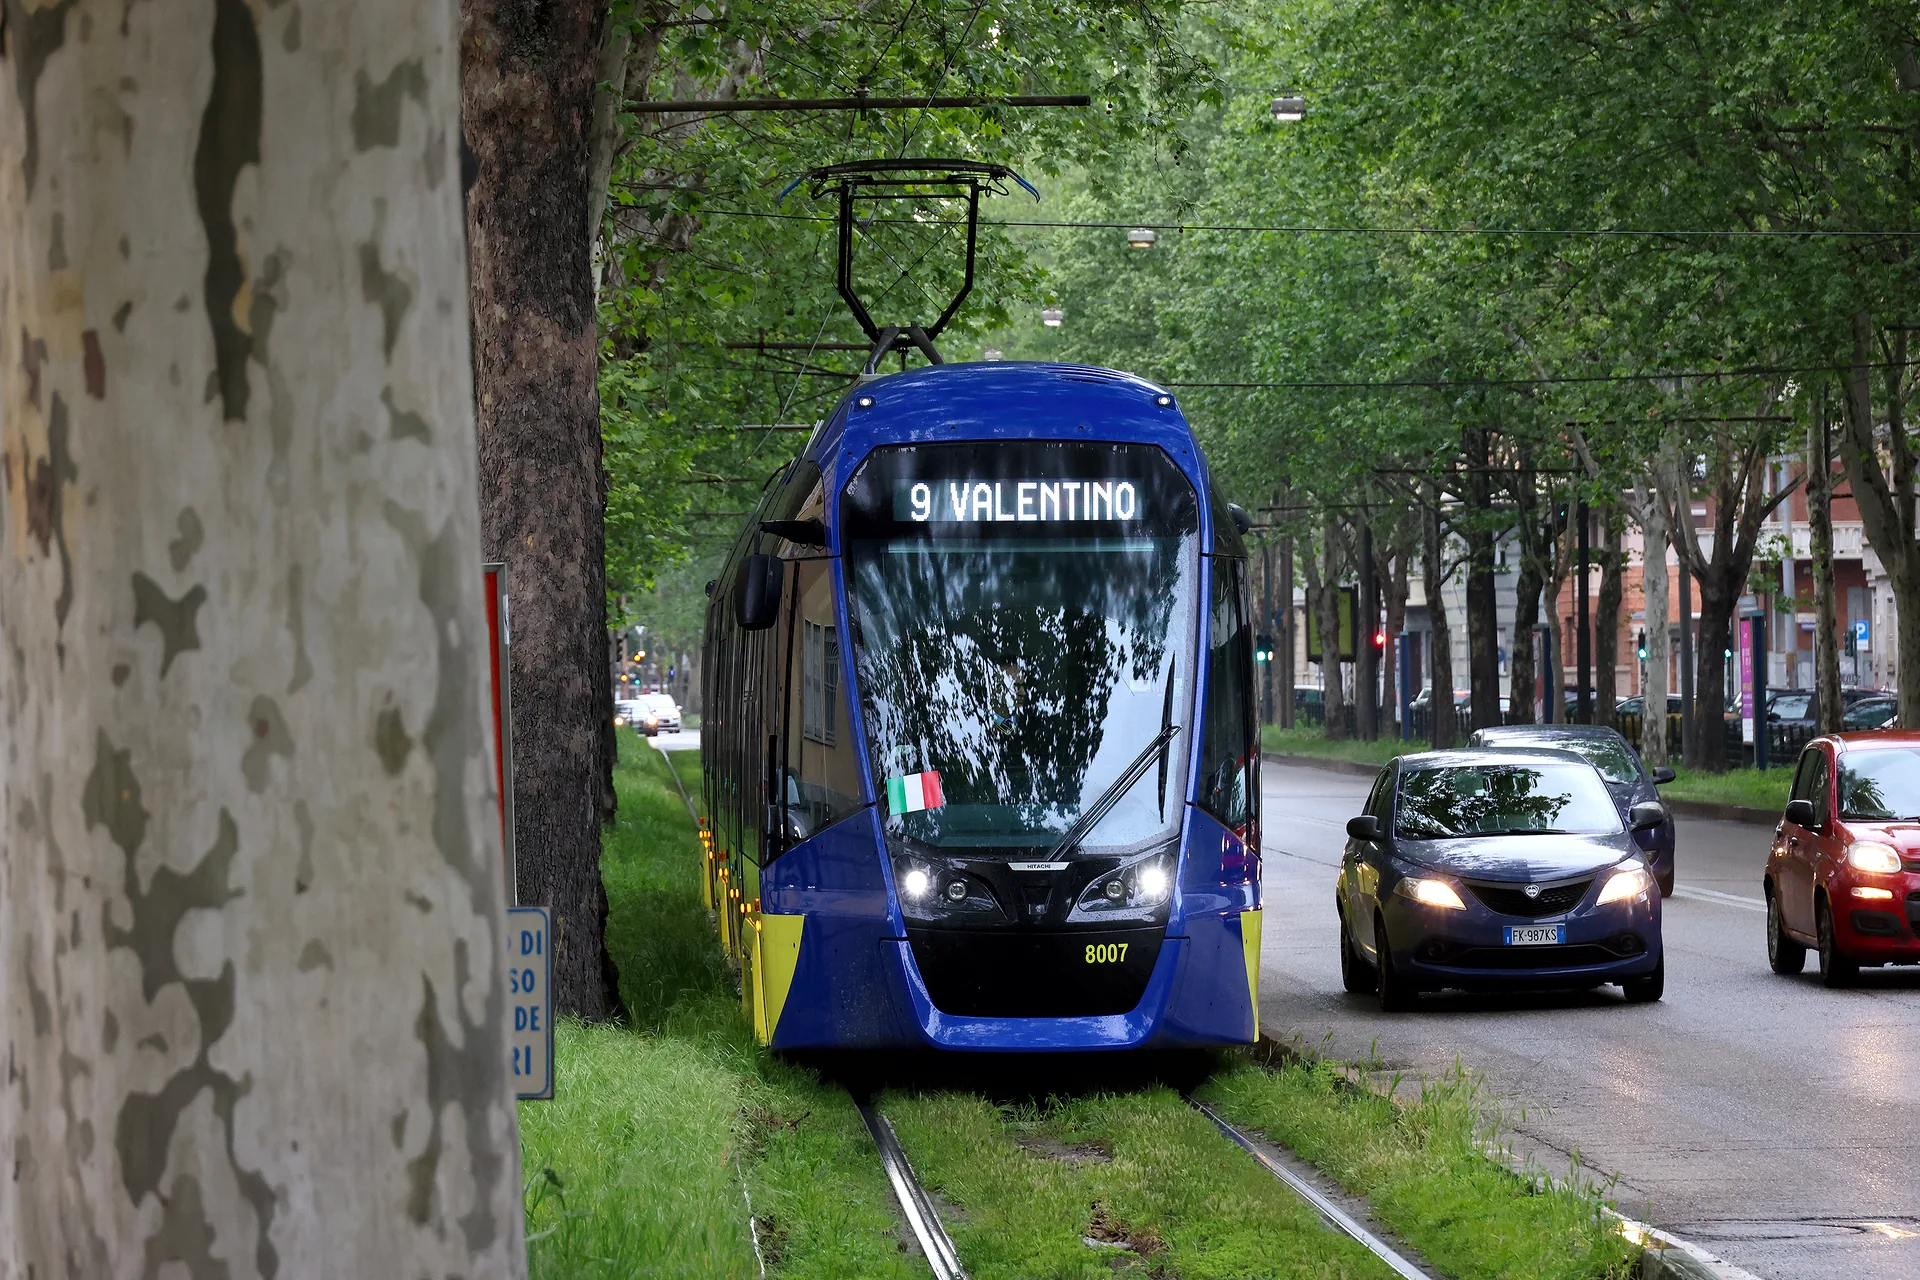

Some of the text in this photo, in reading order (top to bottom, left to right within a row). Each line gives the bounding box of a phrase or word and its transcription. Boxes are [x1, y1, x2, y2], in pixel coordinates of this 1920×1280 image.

[911, 481, 1136, 521] 9 VALENTINO
[521, 930, 542, 955] DI
[1085, 943, 1129, 964] 8007
[515, 1006, 541, 1031] DE
